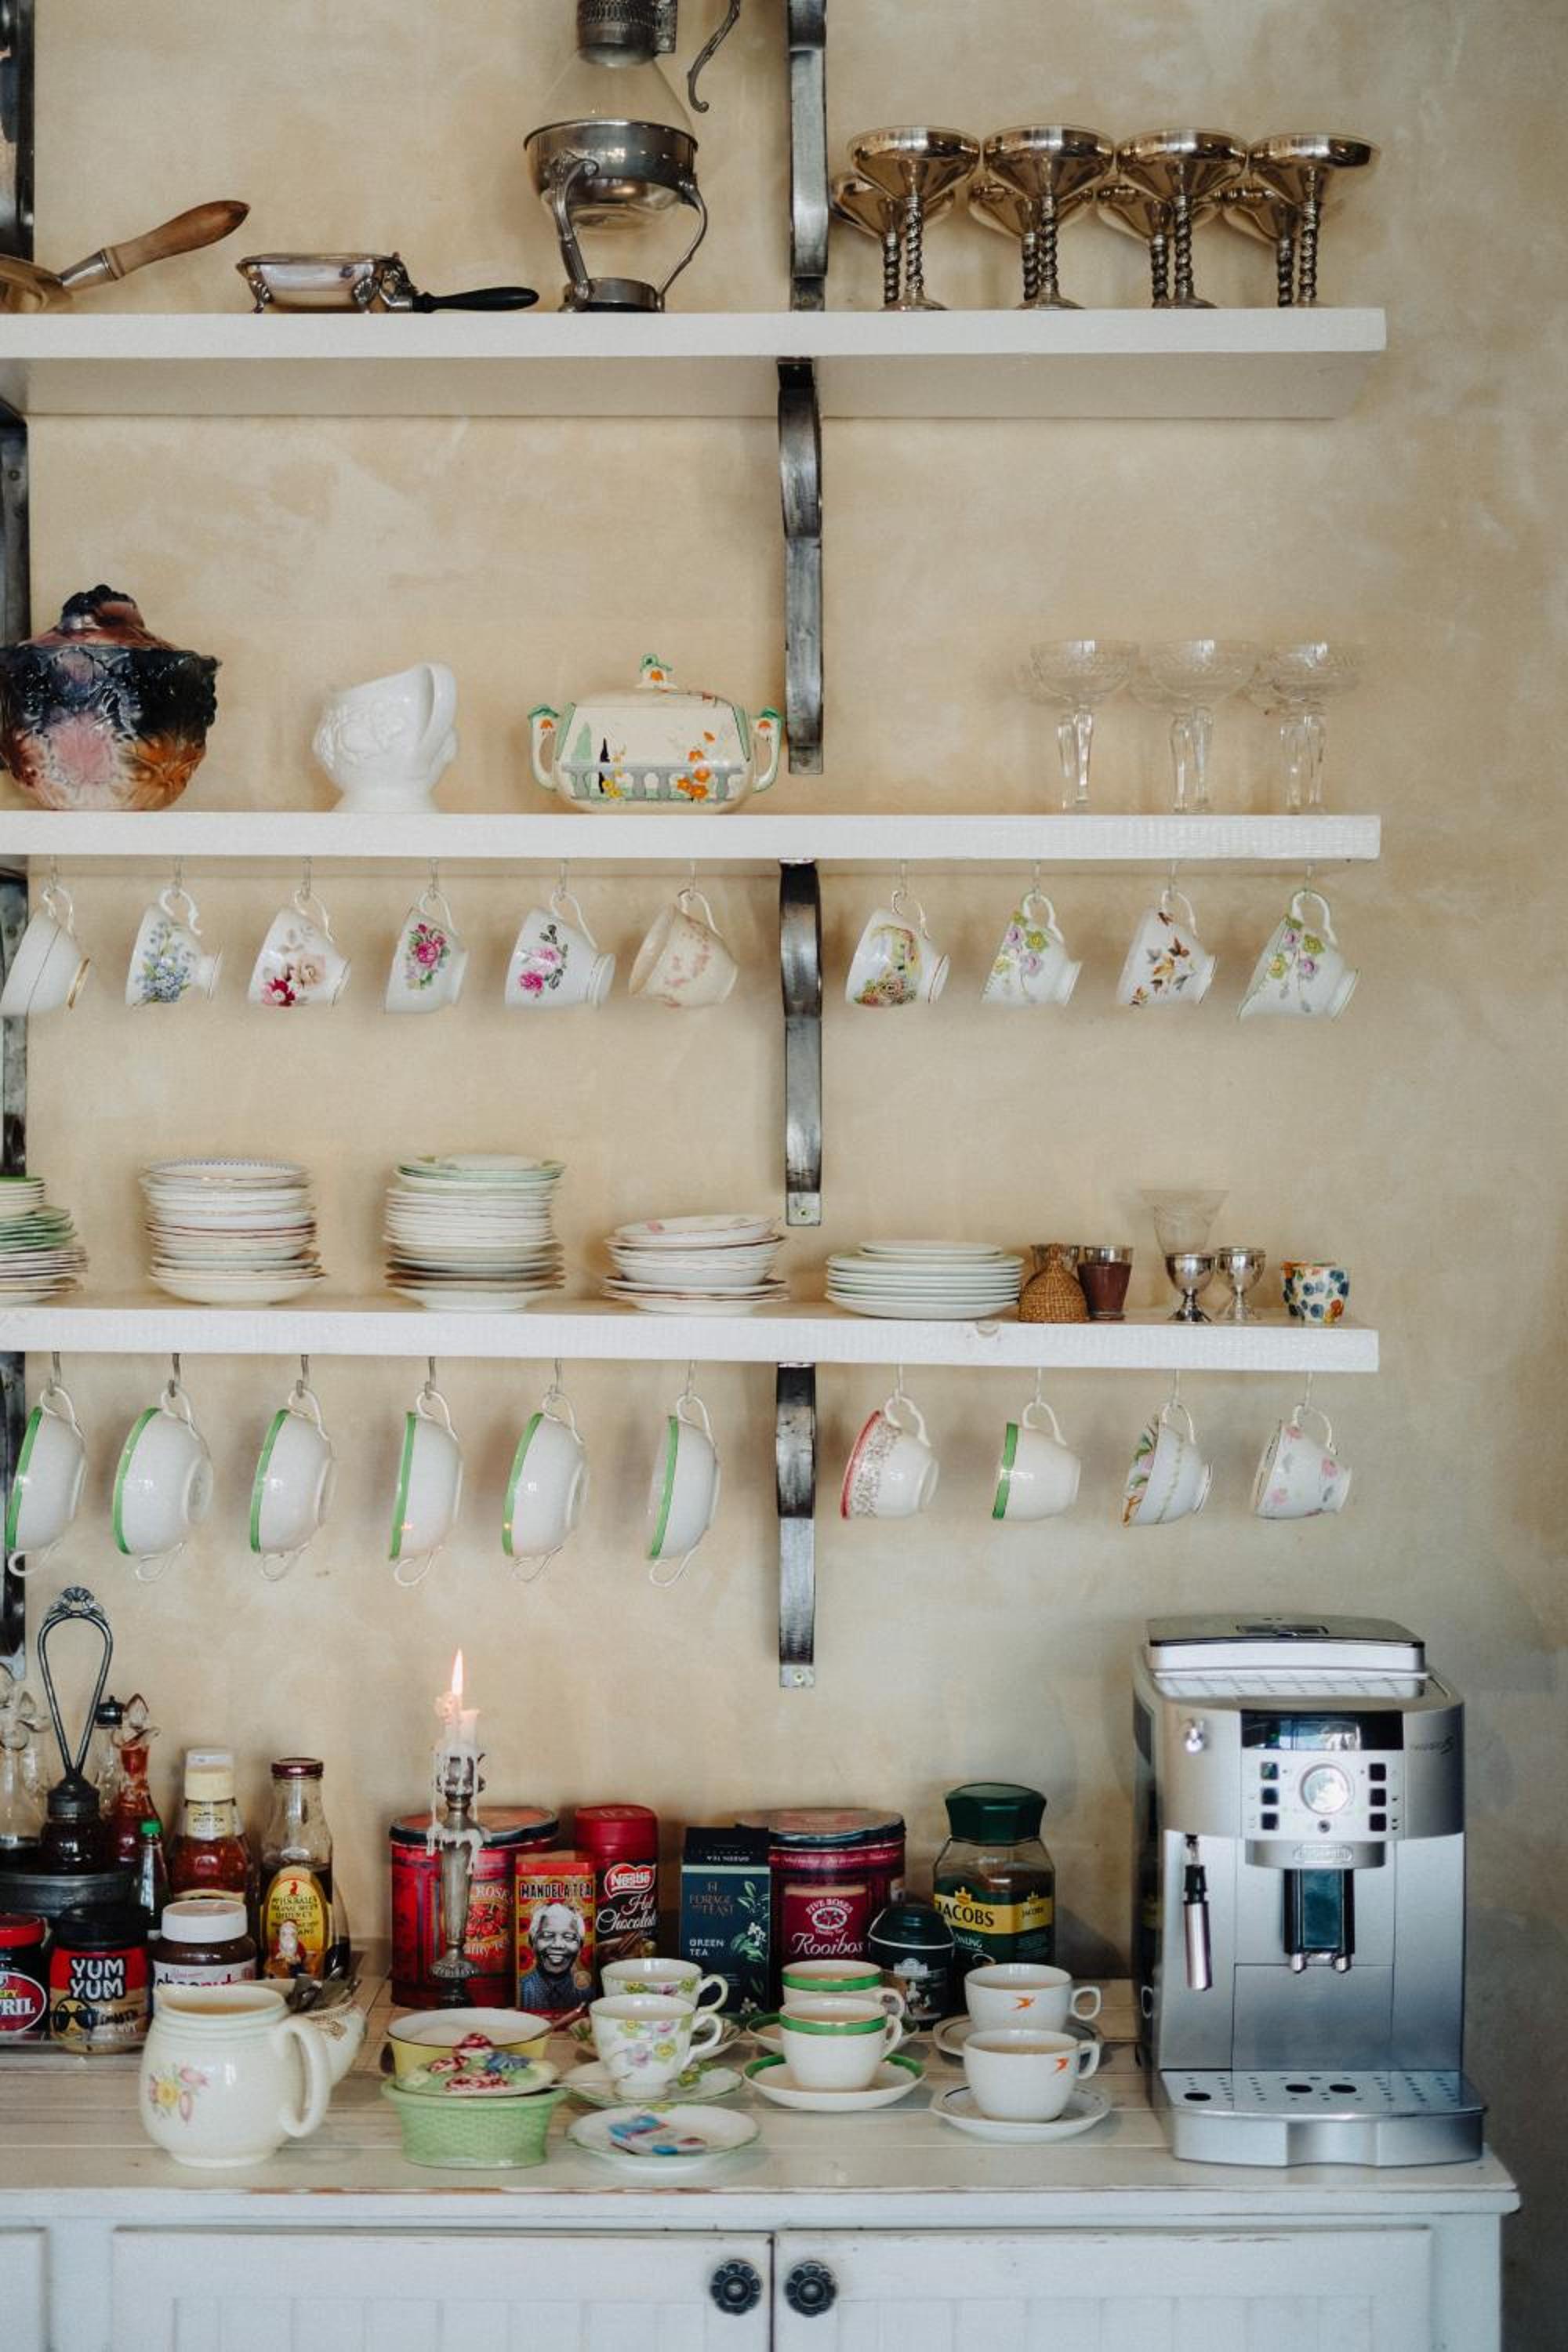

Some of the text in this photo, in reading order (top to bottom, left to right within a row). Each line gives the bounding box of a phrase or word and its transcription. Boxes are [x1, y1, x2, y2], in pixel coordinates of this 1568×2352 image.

[521, 1883, 593, 1898] MANDELA TEA
[805, 1898, 854, 1915] FIVE ROSES
[689, 1938, 724, 1948] GREEN
[791, 1931, 865, 1955] Rooibos
[689, 1948, 709, 1958] TEA
[71, 1958, 125, 1980] YUM
[69, 1977, 124, 2000] YUM
